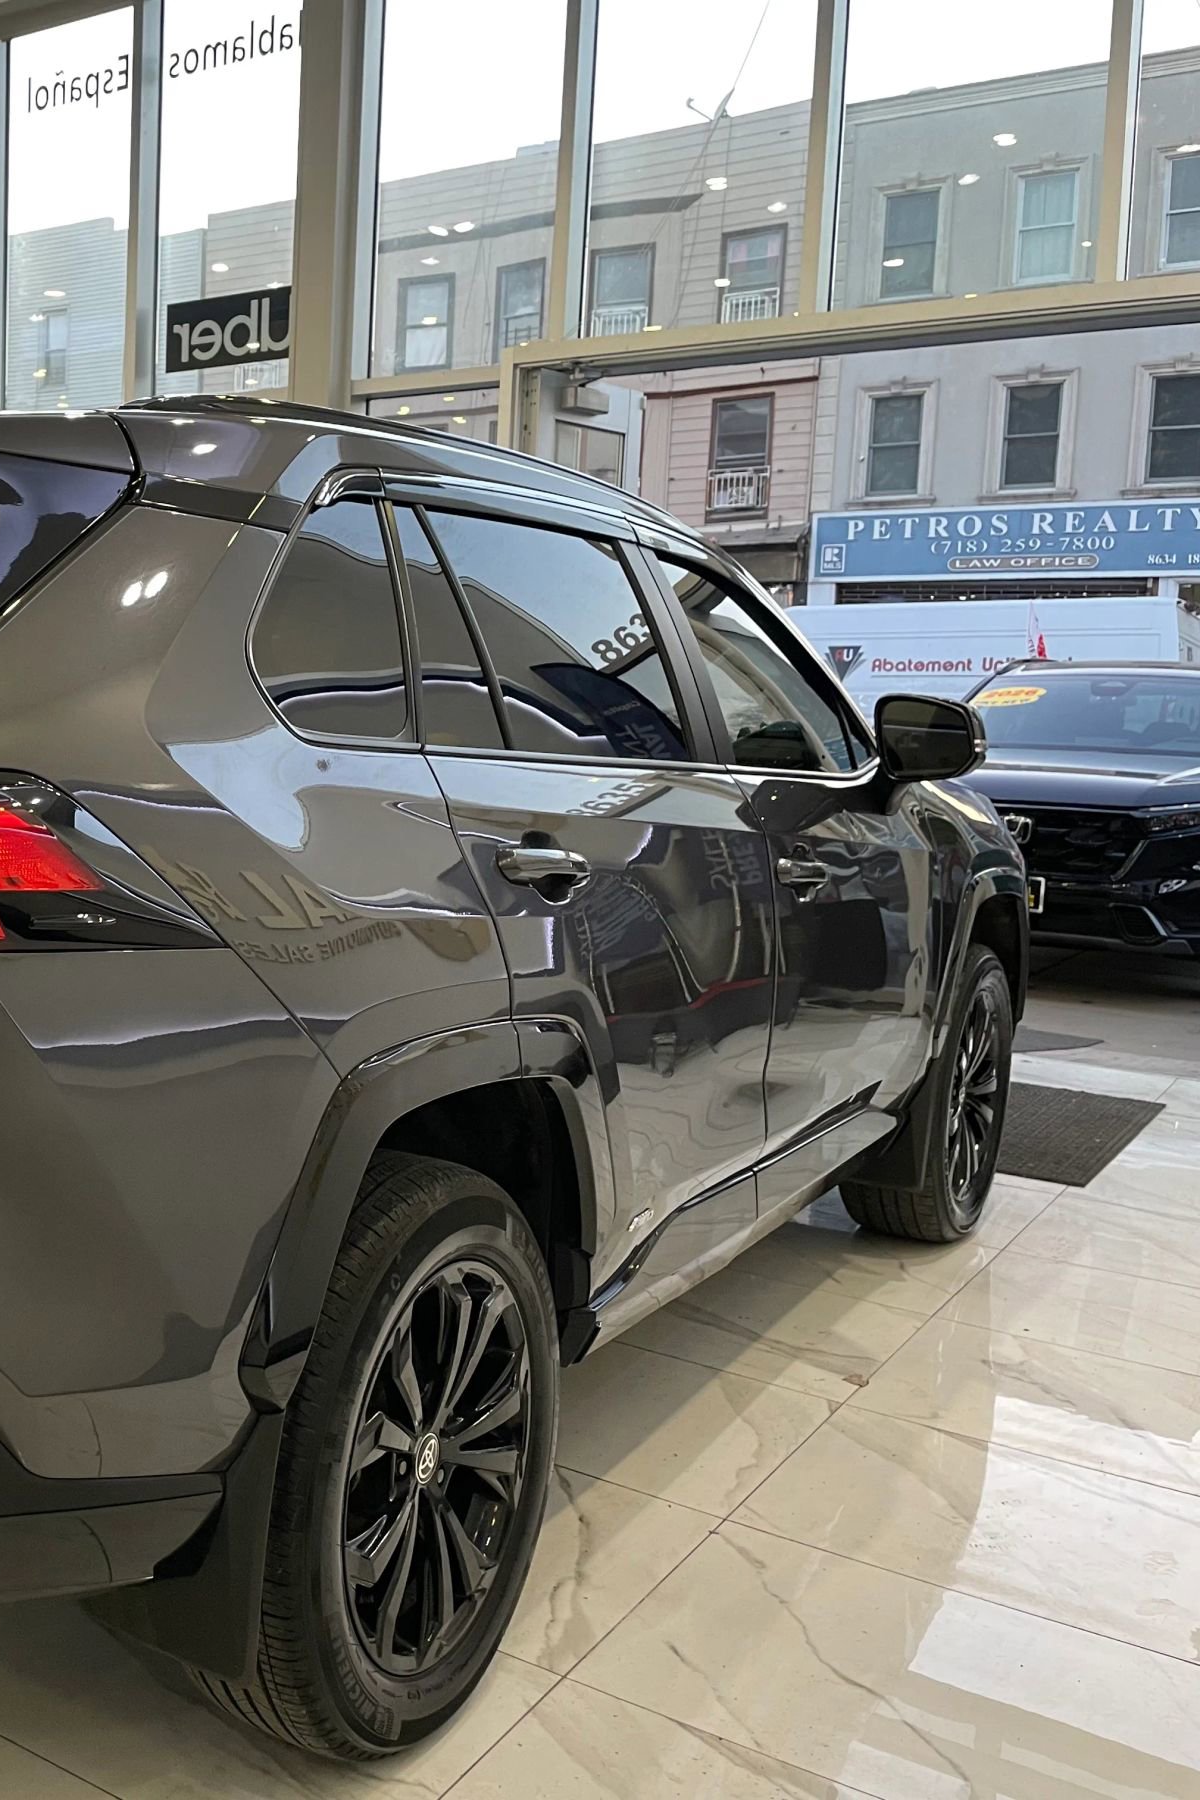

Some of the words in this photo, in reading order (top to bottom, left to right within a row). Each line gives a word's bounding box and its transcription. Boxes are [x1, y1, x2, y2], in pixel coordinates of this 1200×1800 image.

[847, 514, 1009, 541] PETROS
[930, 539, 988, 555] (718)
[1001, 536, 1116, 553] 259-7800
[955, 558, 1002, 569] LAW
[1010, 555, 1092, 567] OFFICE
[871, 658, 973, 673] Abatement
